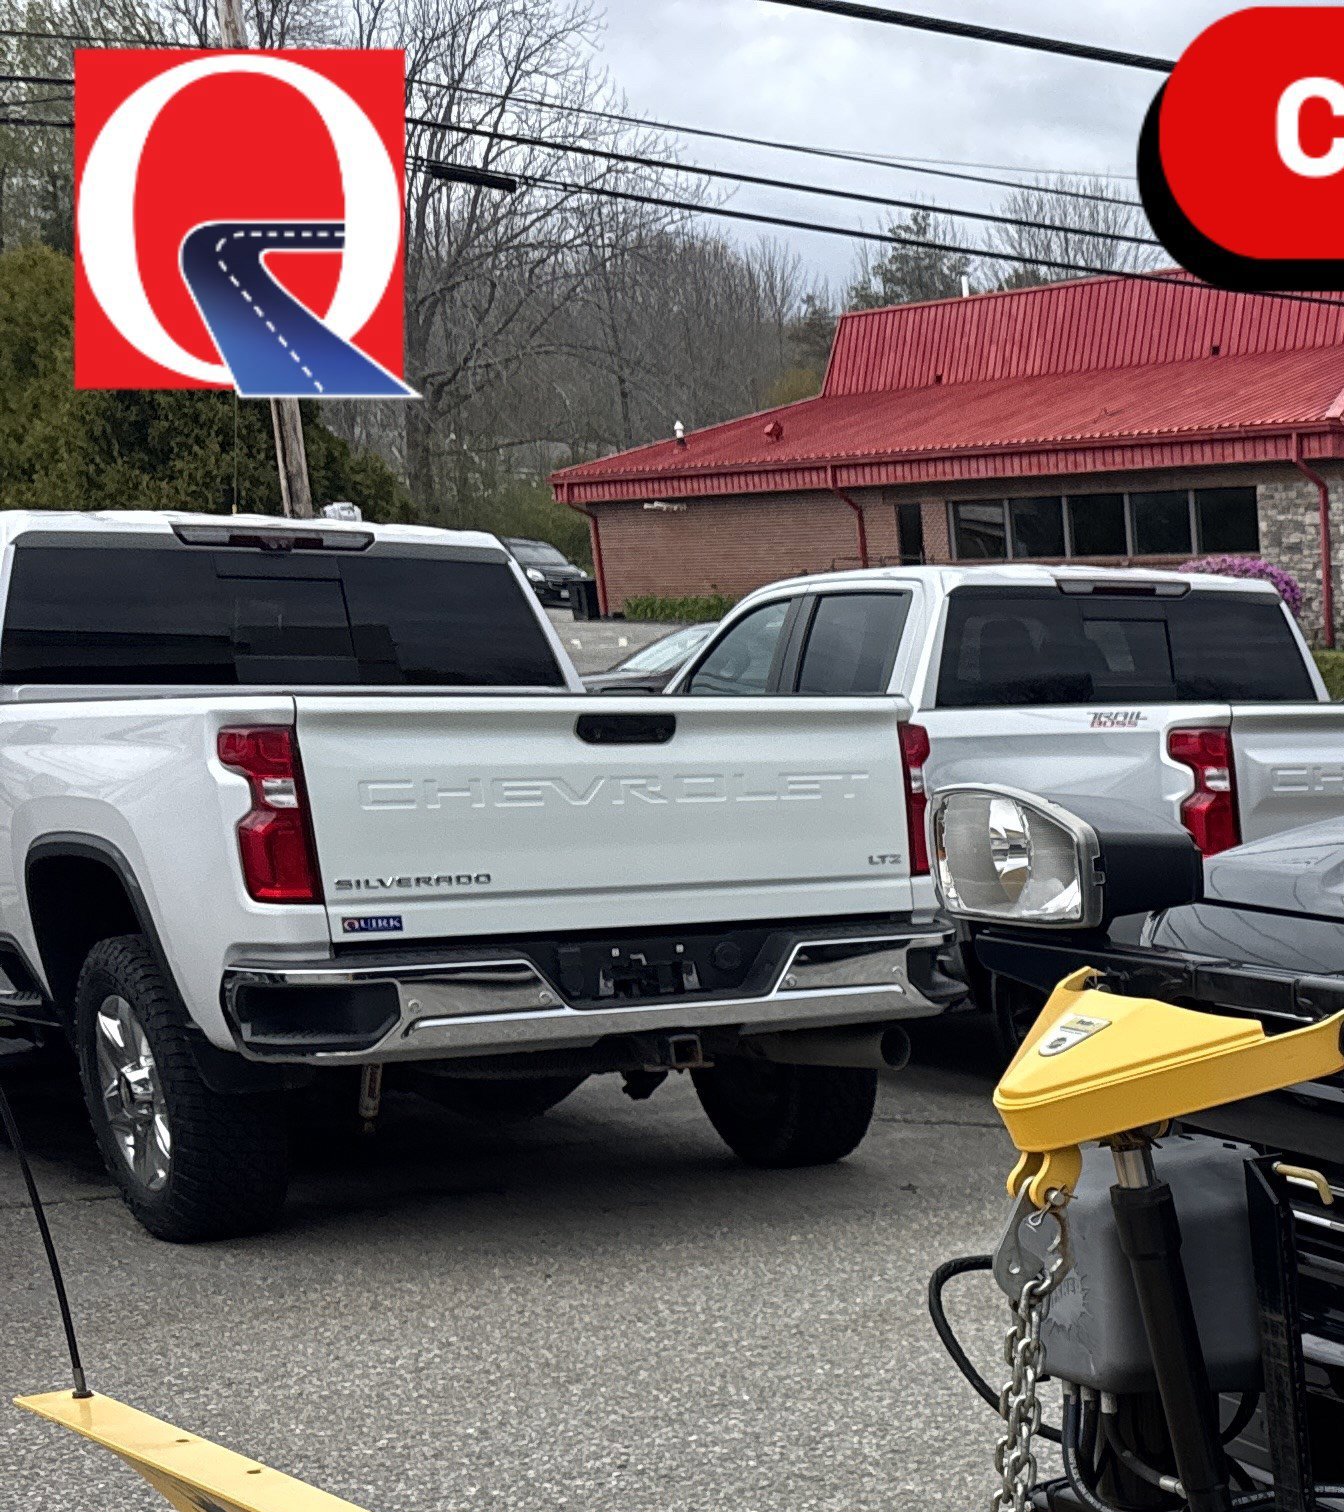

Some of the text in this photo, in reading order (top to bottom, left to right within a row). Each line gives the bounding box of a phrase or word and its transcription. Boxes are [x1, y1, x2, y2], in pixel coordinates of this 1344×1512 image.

[358, 771, 870, 812] CHEVROLET
[868, 853, 902, 865] LTZ
[334, 872, 493, 892] SILVERADO
[343, 917, 401, 931] QUIRK
